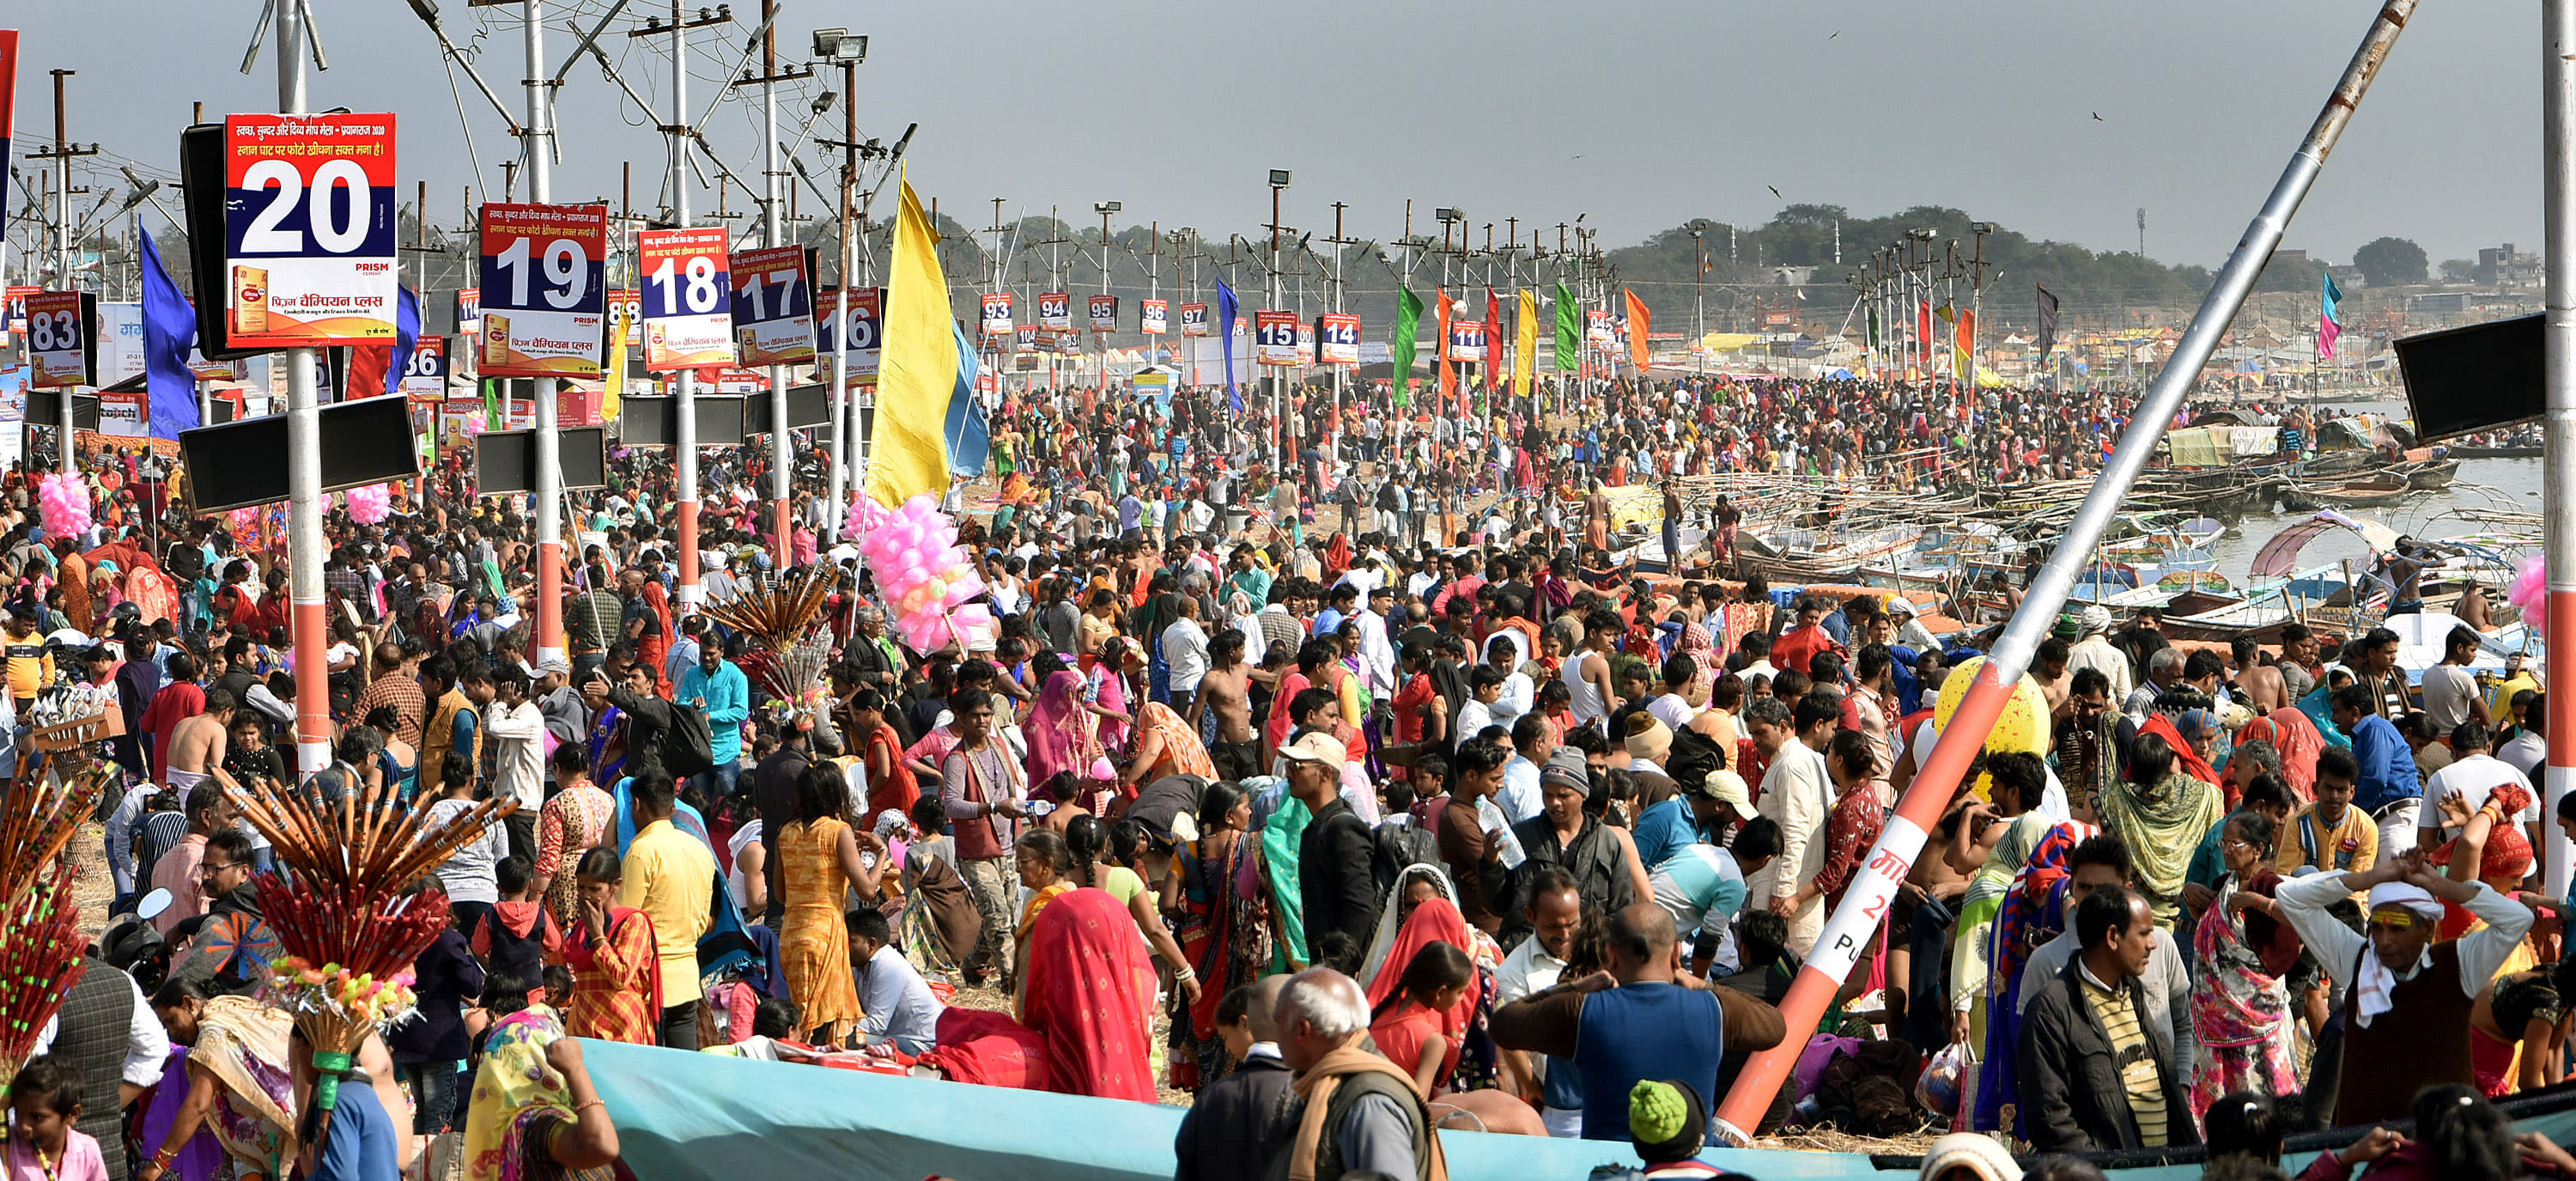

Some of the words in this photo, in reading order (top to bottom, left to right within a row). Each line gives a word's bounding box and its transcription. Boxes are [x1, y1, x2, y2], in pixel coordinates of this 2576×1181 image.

[258, 125, 276, 141] सुन्दर
[276, 122, 289, 136] और
[289, 121, 305, 136] दिव्य
[306, 125, 319, 136] माघ
[319, 122, 334, 136] मेला
[341, 125, 371, 137] प्रयागराज
[372, 125, 386, 136] 2020
[237, 145, 258, 155] स्नान
[259, 145, 274, 155] घाट
[275, 145, 286, 155] पर
[288, 142, 306, 155] फोटो
[356, 145, 372, 155] मना
[240, 160, 371, 253] 20
[355, 263, 388, 271] PRISM
[497, 237, 587, 308] 19
[652, 256, 719, 315] 18
[742, 268, 798, 320] 17
[300, 293, 350, 307] चैम्पियन
[354, 296, 383, 307] प्लस
[1042, 300, 1065, 317] 94
[609, 301, 641, 325] 88
[985, 301, 1008, 319] 93
[1091, 302, 1111, 318] 95
[1145, 305, 1165, 320] 96
[1183, 309, 1203, 323] 97
[33, 310, 76, 350] 83
[823, 307, 872, 350] 16
[1590, 316, 1605, 329] 04
[1020, 330, 1036, 343] 104
[1262, 323, 1291, 345] 15
[1327, 322, 1354, 344] 14
[1456, 329, 1476, 346] 11
